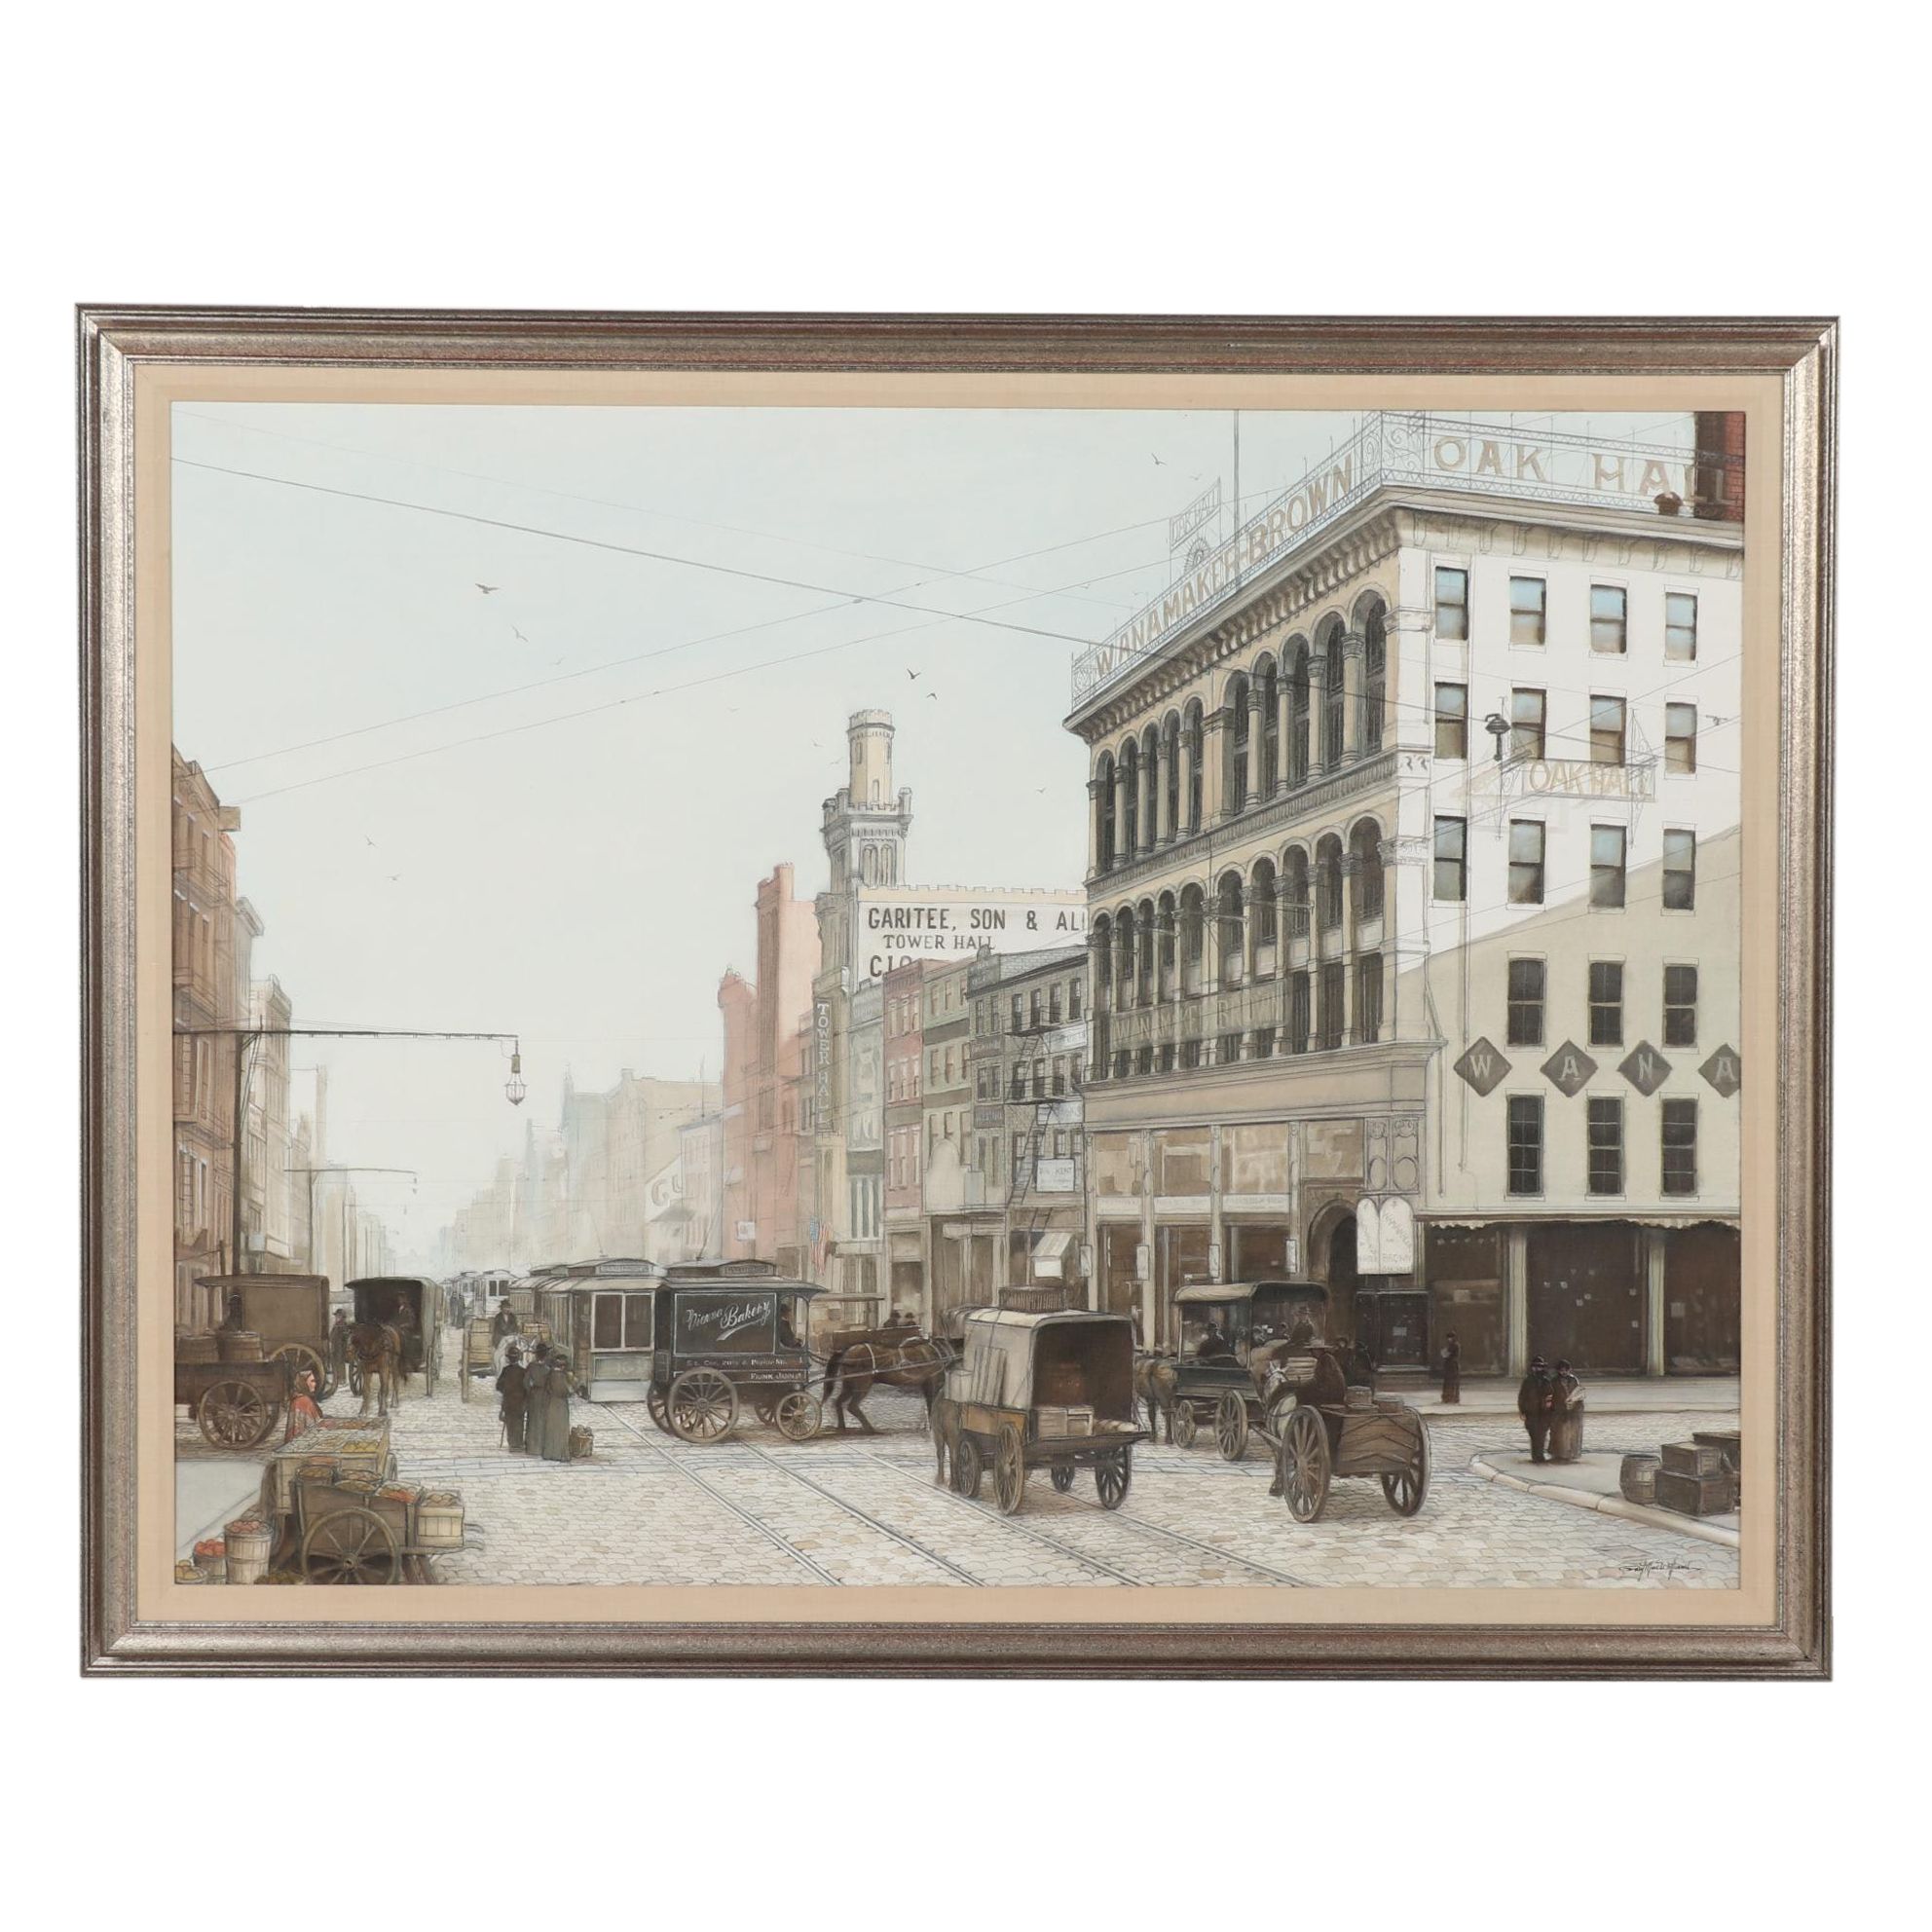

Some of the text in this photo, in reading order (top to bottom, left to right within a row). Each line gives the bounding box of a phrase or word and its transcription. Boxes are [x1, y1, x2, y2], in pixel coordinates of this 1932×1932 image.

[1433, 435, 1549, 483] OAK
[1529, 762, 1584, 795] OAK
[868, 907, 1086, 931] GARITEE, SON & AL
[882, 934, 995, 950] TOWER HALL
[816, 1003, 831, 1064] TOWER
[721, 1301, 771, 1329] Bakery
